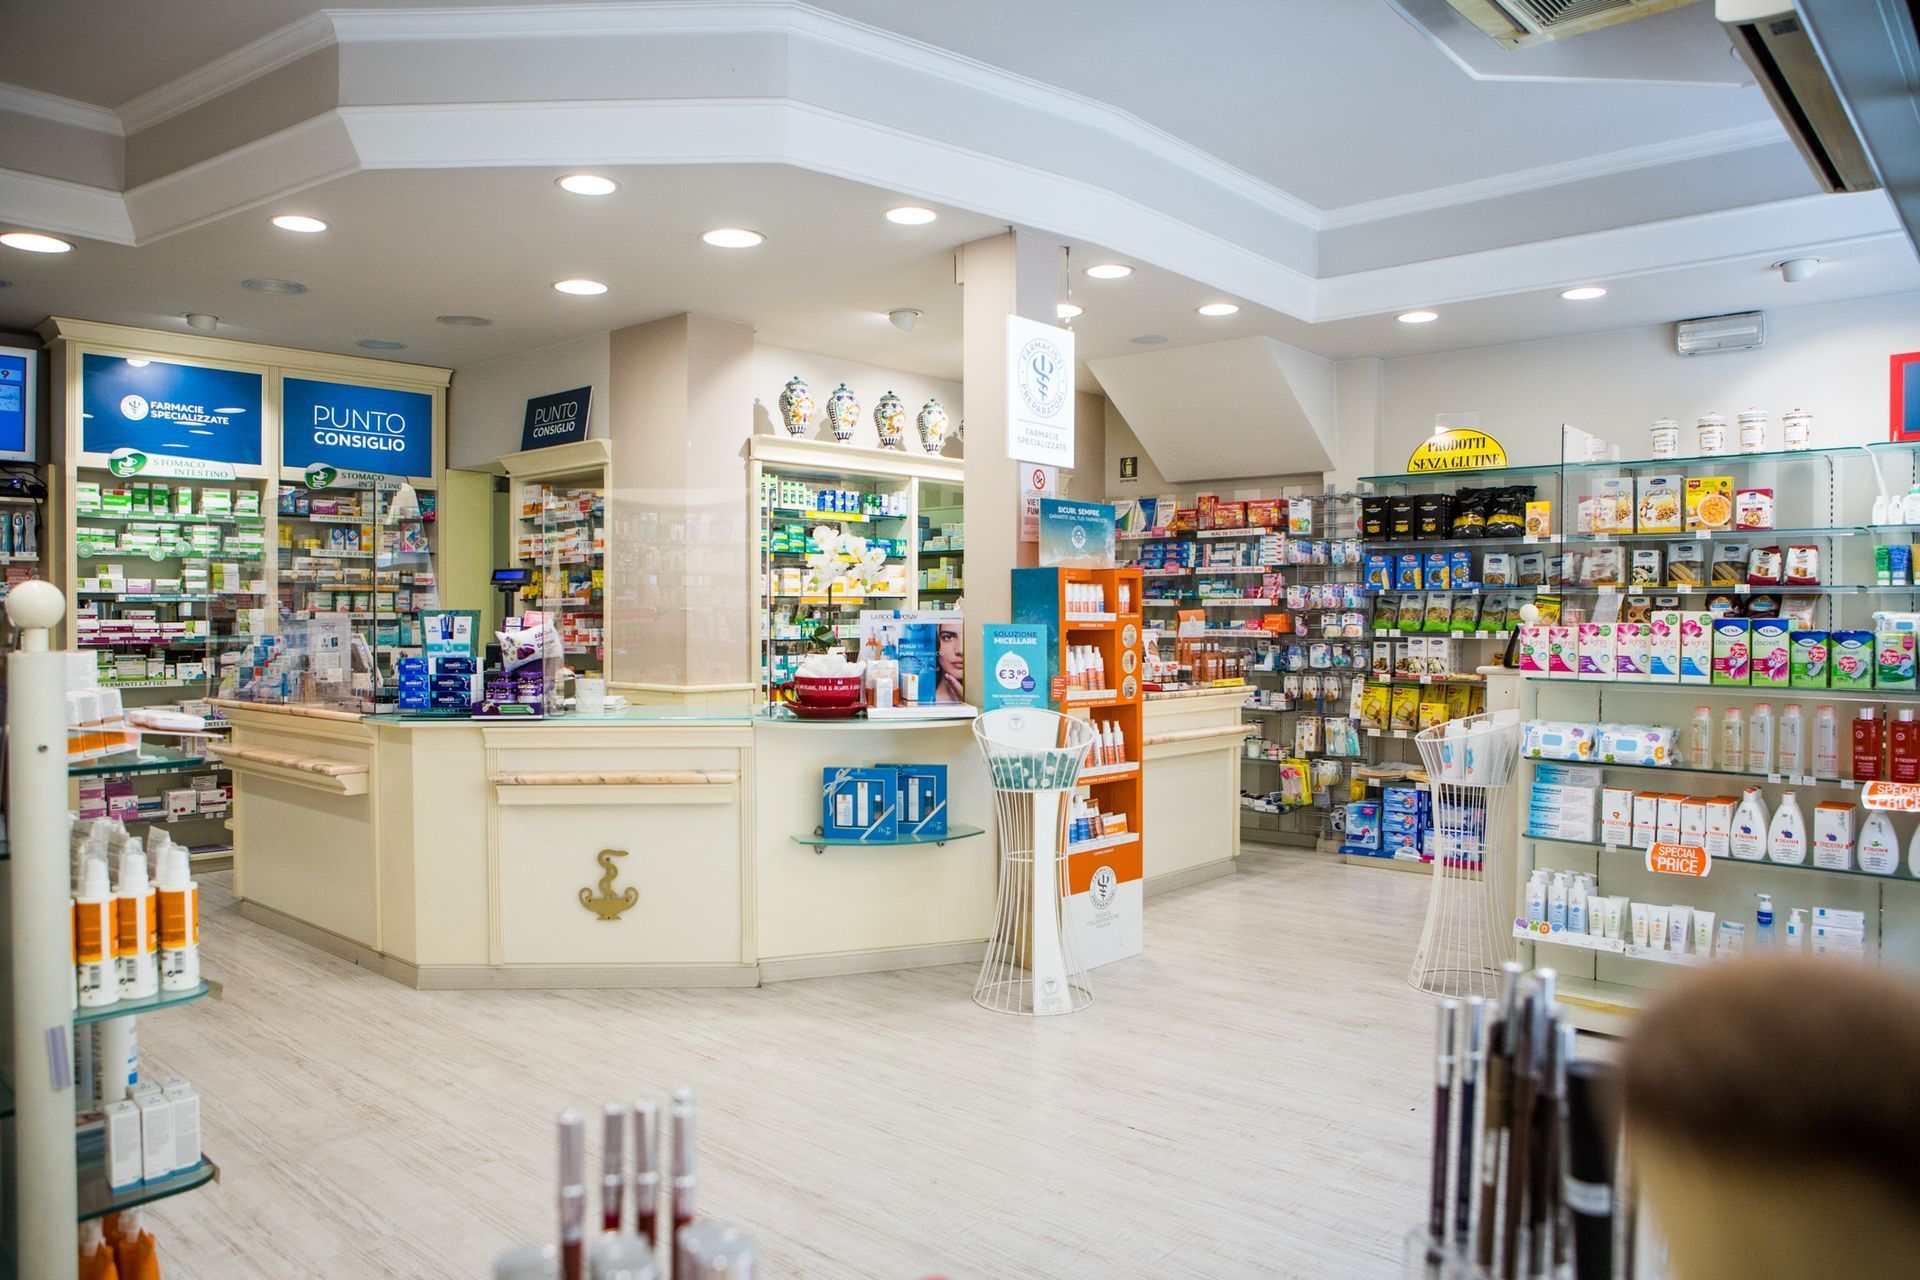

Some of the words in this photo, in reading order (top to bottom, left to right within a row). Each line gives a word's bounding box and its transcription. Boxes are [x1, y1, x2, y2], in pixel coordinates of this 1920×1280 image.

[150, 401, 204, 414] FARMACIE
[534, 402, 578, 424] PUNTO
[150, 411, 229, 425] SPECIALIZZATE
[314, 405, 405, 434] PUNTO
[533, 422, 575, 438] CONSIGLIO
[1026, 428, 1058, 440] FARMACIE
[314, 431, 405, 452] CONSIGLIO
[1018, 436, 1066, 452] SPECIALIZZATE
[1428, 437, 1486, 452] PRODOTTI
[153, 458, 206, 469] STOMACO
[1413, 457, 1447, 470] SENZA
[1451, 453, 1500, 467] GLUTINE
[174, 468, 228, 478] INTESTINO
[342, 472, 384, 482] STOMACO
[1027, 506, 1039, 515] FUM
[1658, 846, 1698, 859] SPECIAL
[1657, 857, 1698, 873] PRICE
